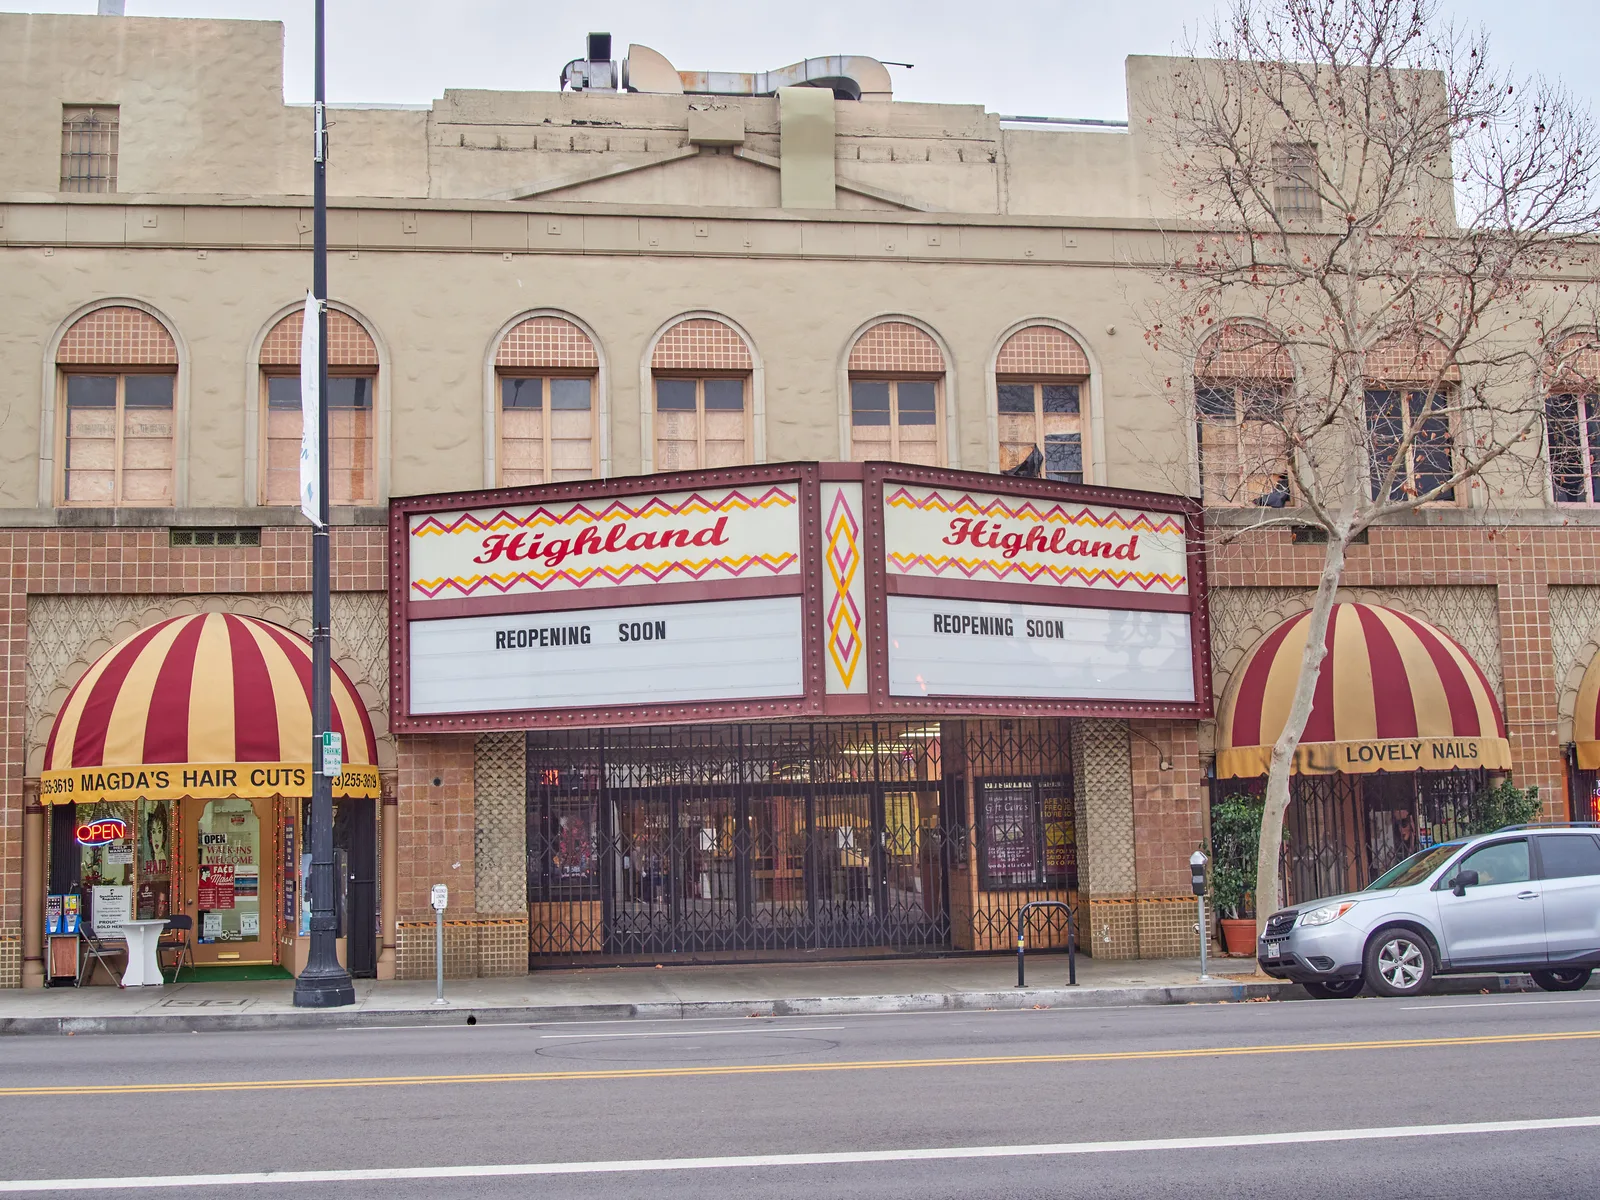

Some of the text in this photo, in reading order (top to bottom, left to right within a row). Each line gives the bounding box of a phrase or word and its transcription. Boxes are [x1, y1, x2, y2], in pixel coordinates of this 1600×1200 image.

[472, 516, 729, 567] Highland
[942, 517, 1140, 561] Highland
[495, 620, 666, 649] REOPENING SOON
[933, 613, 1064, 638] REOPENING SOON
[1346, 744, 1422, 763] LOVELY
[1432, 742, 1478, 760] NAILS
[81, 771, 170, 791] MAGDA'S
[183, 769, 237, 787] HAIR
[250, 768, 305, 786] CUTS
[76, 824, 125, 840] OPEN
[204, 834, 226, 845] OPEN
[207, 845, 252, 854] WALK-INS
[145, 859, 167, 875] HAIR
[206, 855, 253, 864] WELCOME
[210, 874, 234, 884] Mask
